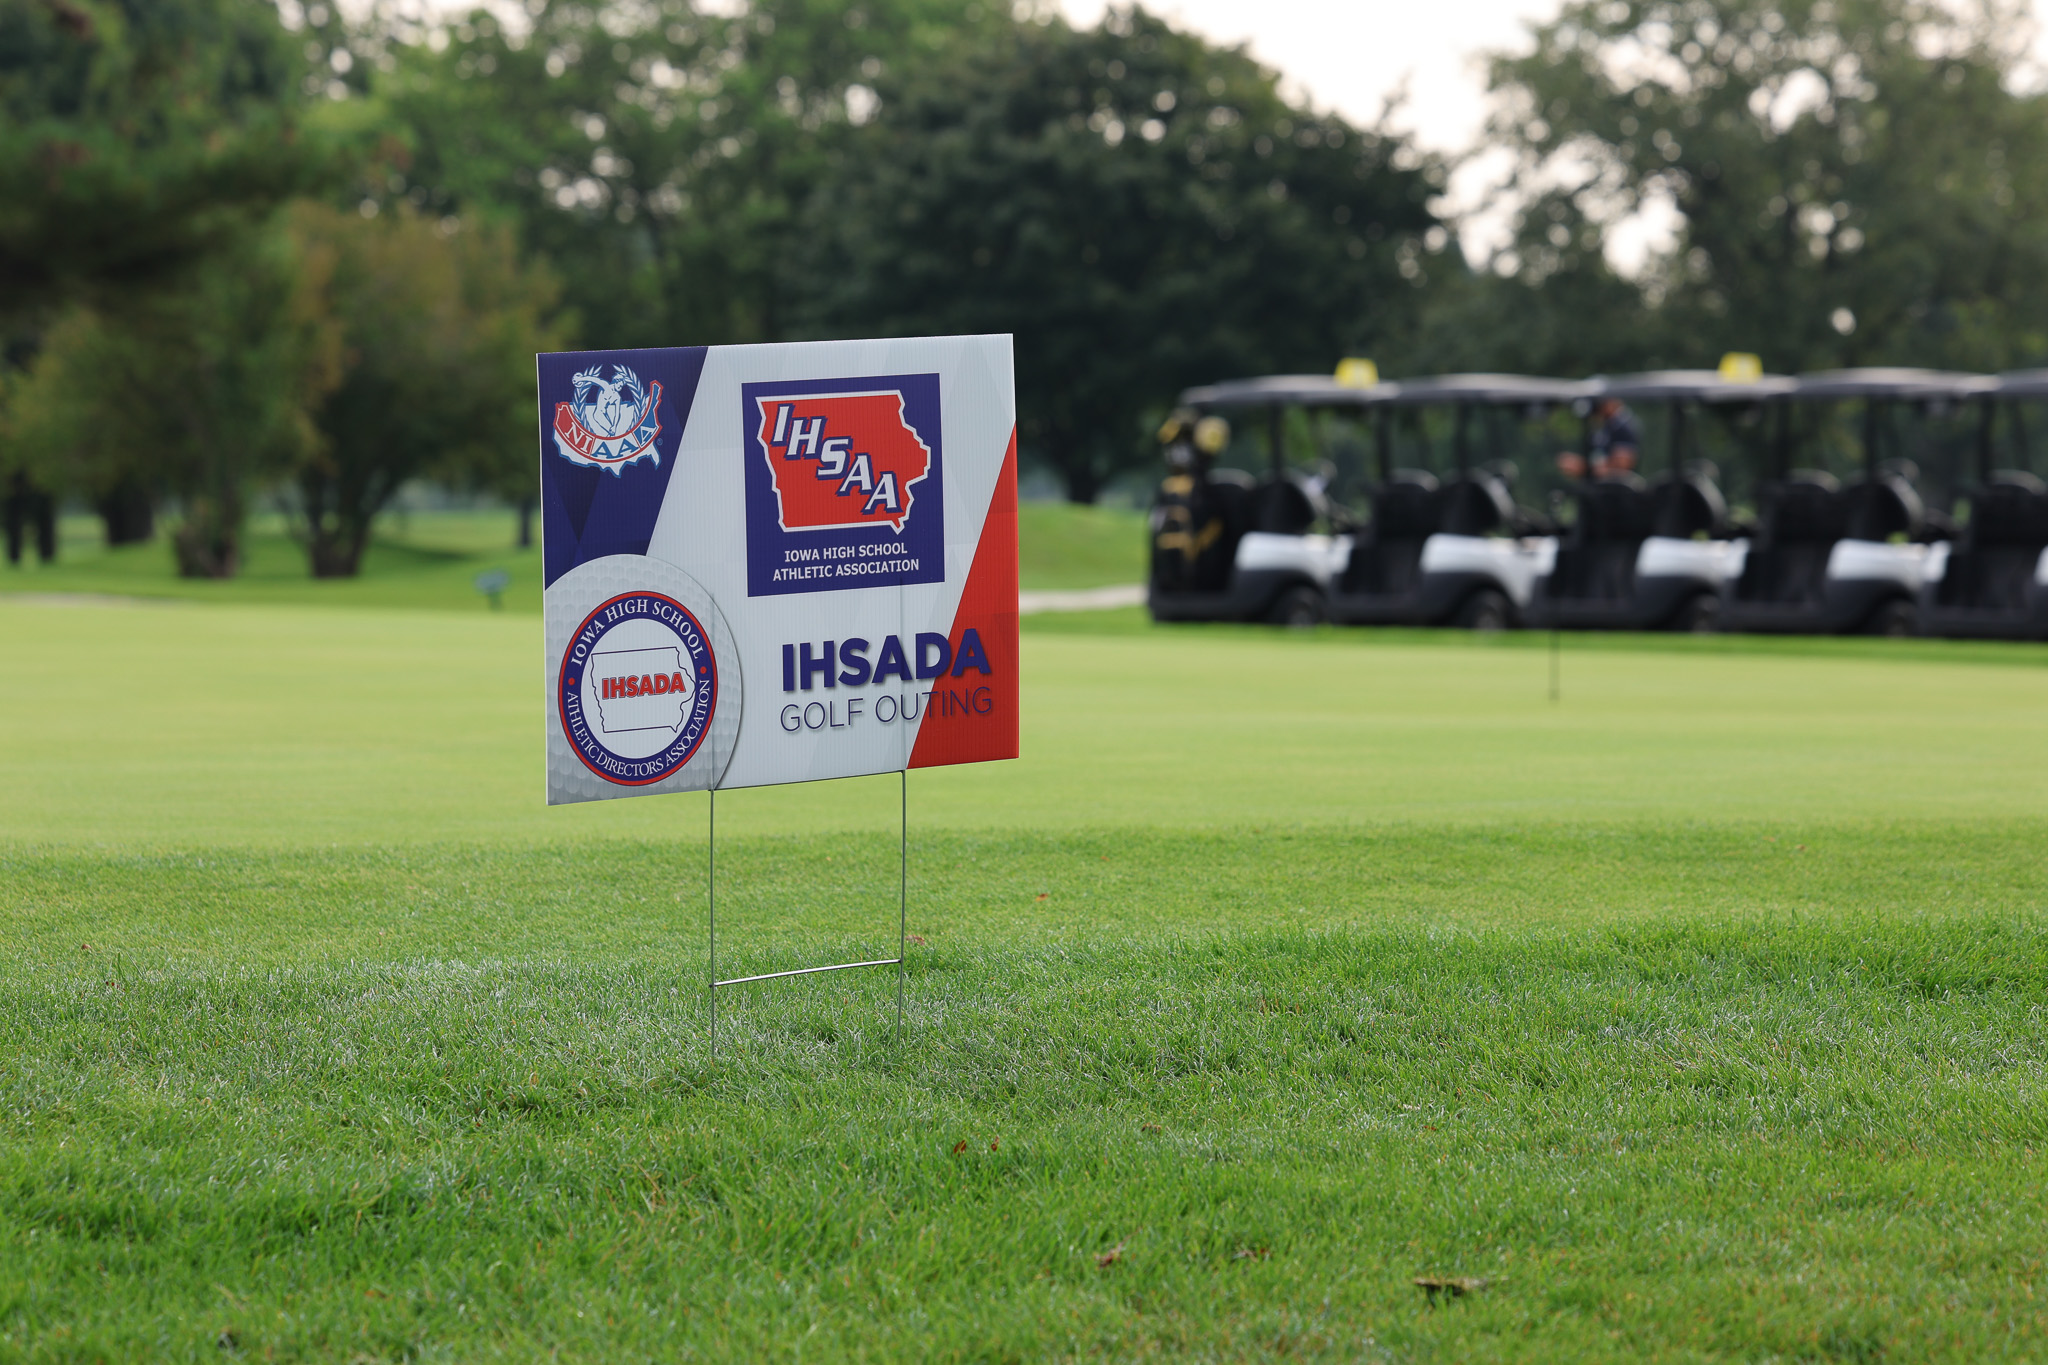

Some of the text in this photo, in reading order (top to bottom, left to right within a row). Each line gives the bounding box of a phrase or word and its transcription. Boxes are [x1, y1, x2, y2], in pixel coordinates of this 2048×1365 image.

[565, 422, 656, 459] NIAAA
[769, 403, 903, 515] IHSAA
[772, 559, 920, 582] ATHLETIC ASSOCIATION
[784, 542, 908, 563] IOWA HIGH SCHOOL
[570, 599, 704, 666] IOWA HIGH SCHOOL
[782, 628, 992, 692] IHSADA
[602, 672, 686, 700] IHSADA
[780, 686, 992, 732] GOLF OUTING
[567, 679, 710, 776] ATHLETIC DIRECTORS ASSOCIATION
